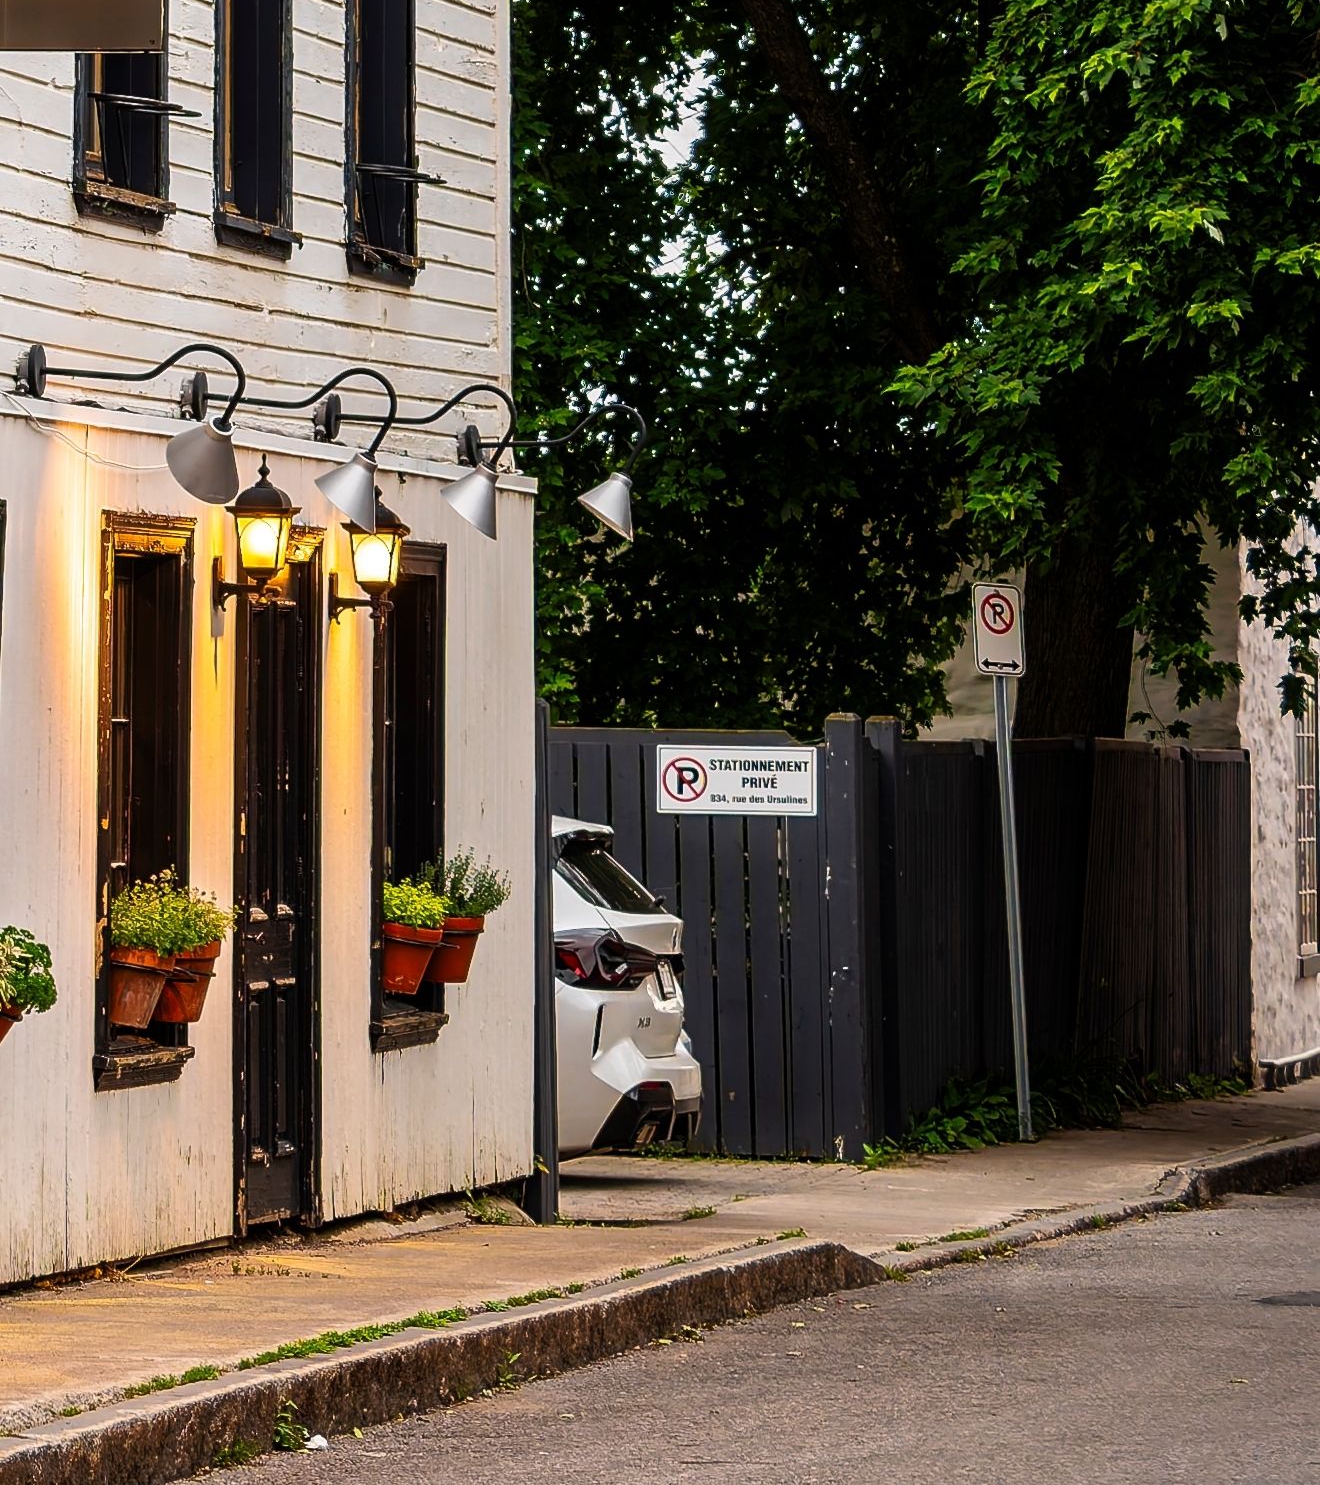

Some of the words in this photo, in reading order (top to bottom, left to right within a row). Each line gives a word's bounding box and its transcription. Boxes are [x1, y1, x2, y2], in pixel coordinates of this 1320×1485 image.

[709, 759, 810, 773] STATIONNEMENT
[742, 774, 778, 789] PRIVÉ
[732, 795, 746, 803] rue
[748, 794, 765, 804] des
[767, 794, 808, 804] Ursulines
